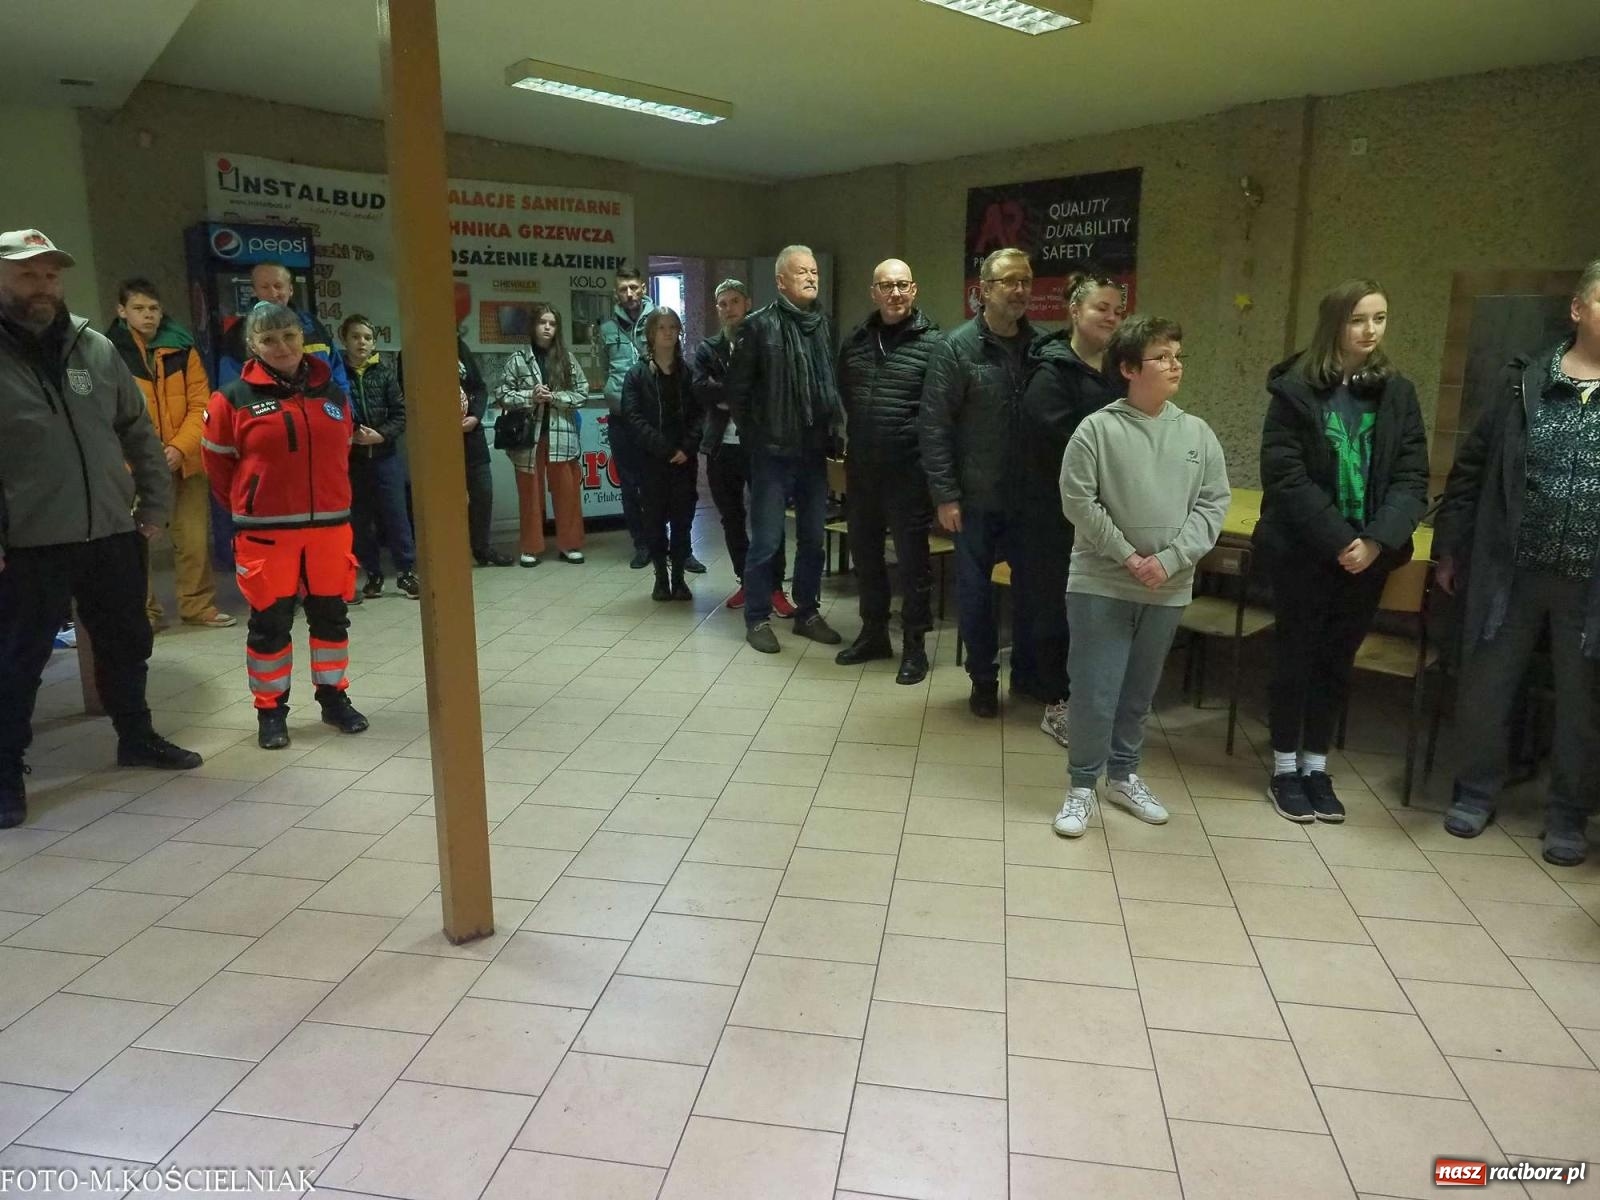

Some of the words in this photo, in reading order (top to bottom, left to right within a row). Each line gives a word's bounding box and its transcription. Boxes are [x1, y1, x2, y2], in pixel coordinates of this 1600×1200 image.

[448, 190, 515, 209] ALACJE
[521, 195, 622, 216] SANITARNE
[1048, 197, 1110, 219] QUALITY
[449, 220, 512, 239] HNIKA
[518, 223, 615, 243] GRZEWCZA
[1045, 217, 1132, 239] DURABILITY
[249, 236, 307, 258] pepsi
[451, 245, 538, 267] SAŻENIE
[1043, 243, 1095, 260] SAFETY
[319, 280, 342, 298] 18
[320, 302, 343, 320] 14
